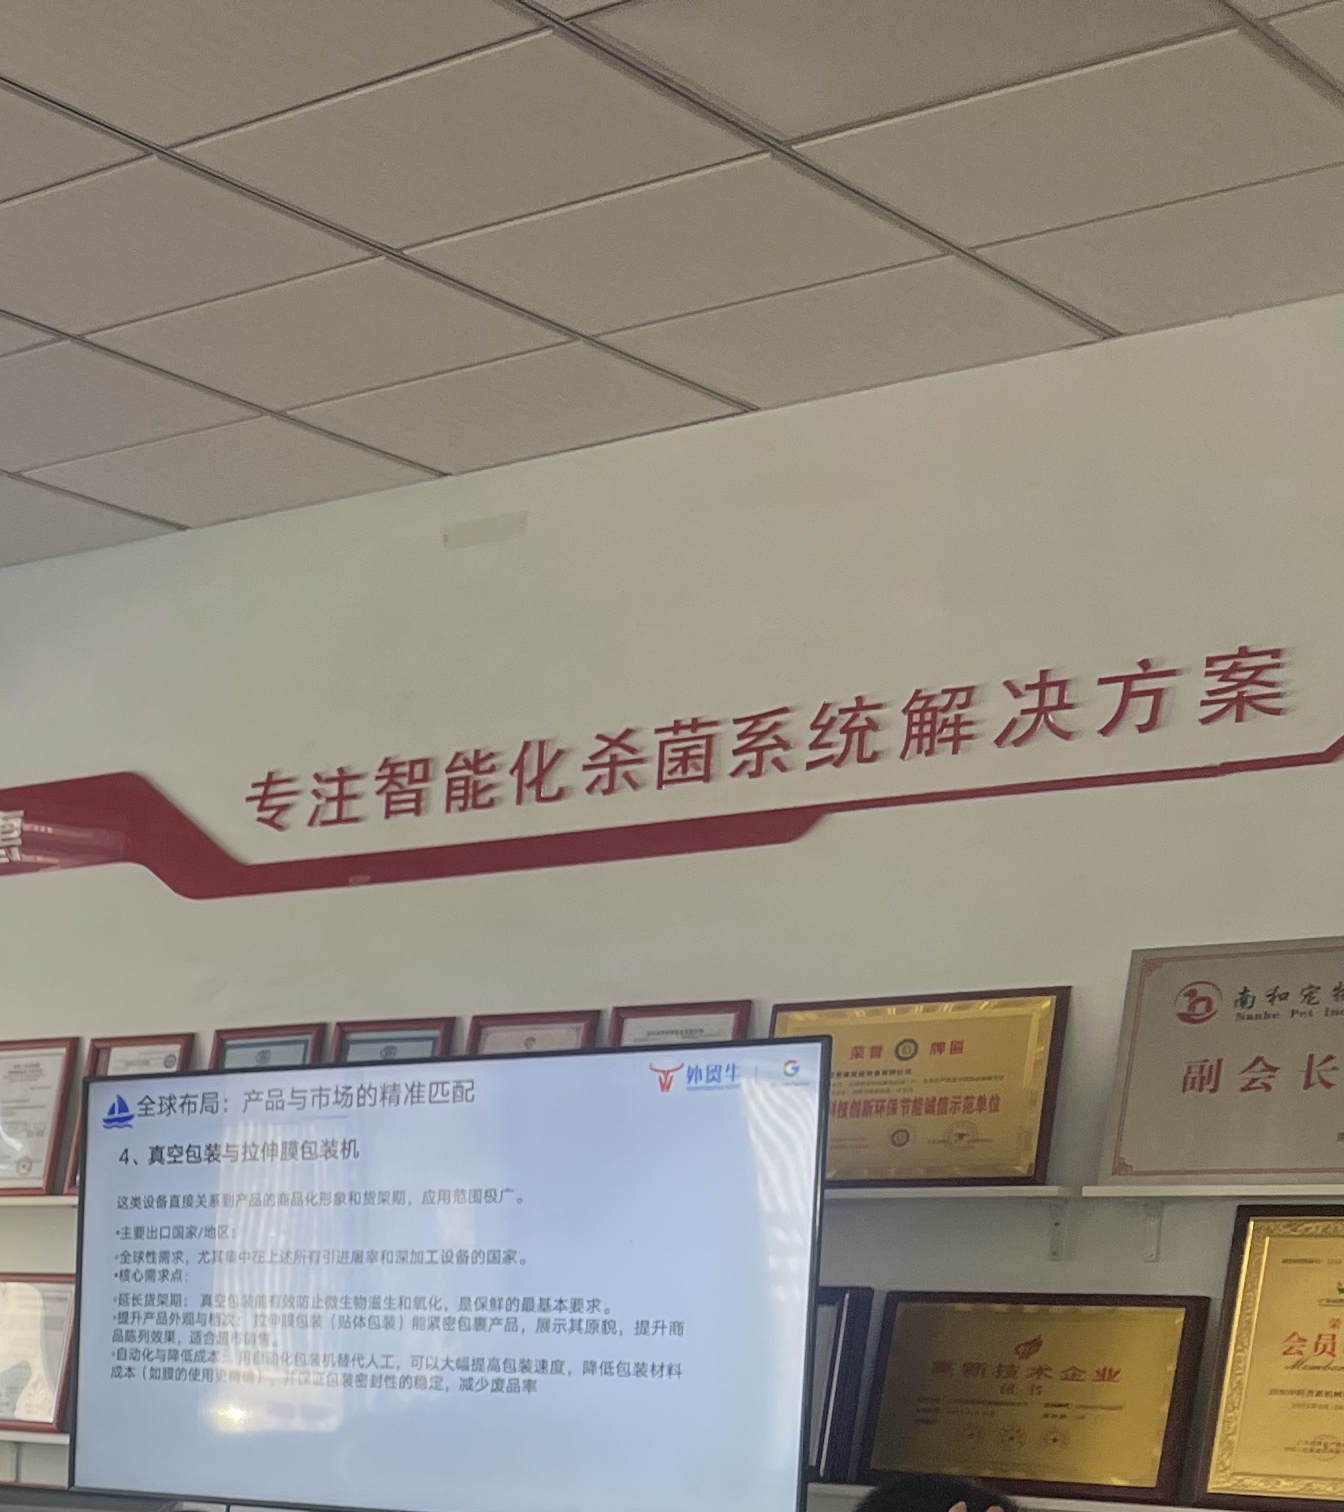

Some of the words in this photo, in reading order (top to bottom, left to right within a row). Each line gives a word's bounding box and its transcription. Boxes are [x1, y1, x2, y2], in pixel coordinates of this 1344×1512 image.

[245, 646, 1288, 832] 专注智能化杀菌系统解决方案
[1181, 1053, 1340, 1095] 副会长
[137, 1078, 476, 1119] 全球布局：产品与市场的精准匹配
[119, 1138, 360, 1167] 4、真空包装与拉伸膜包装机
